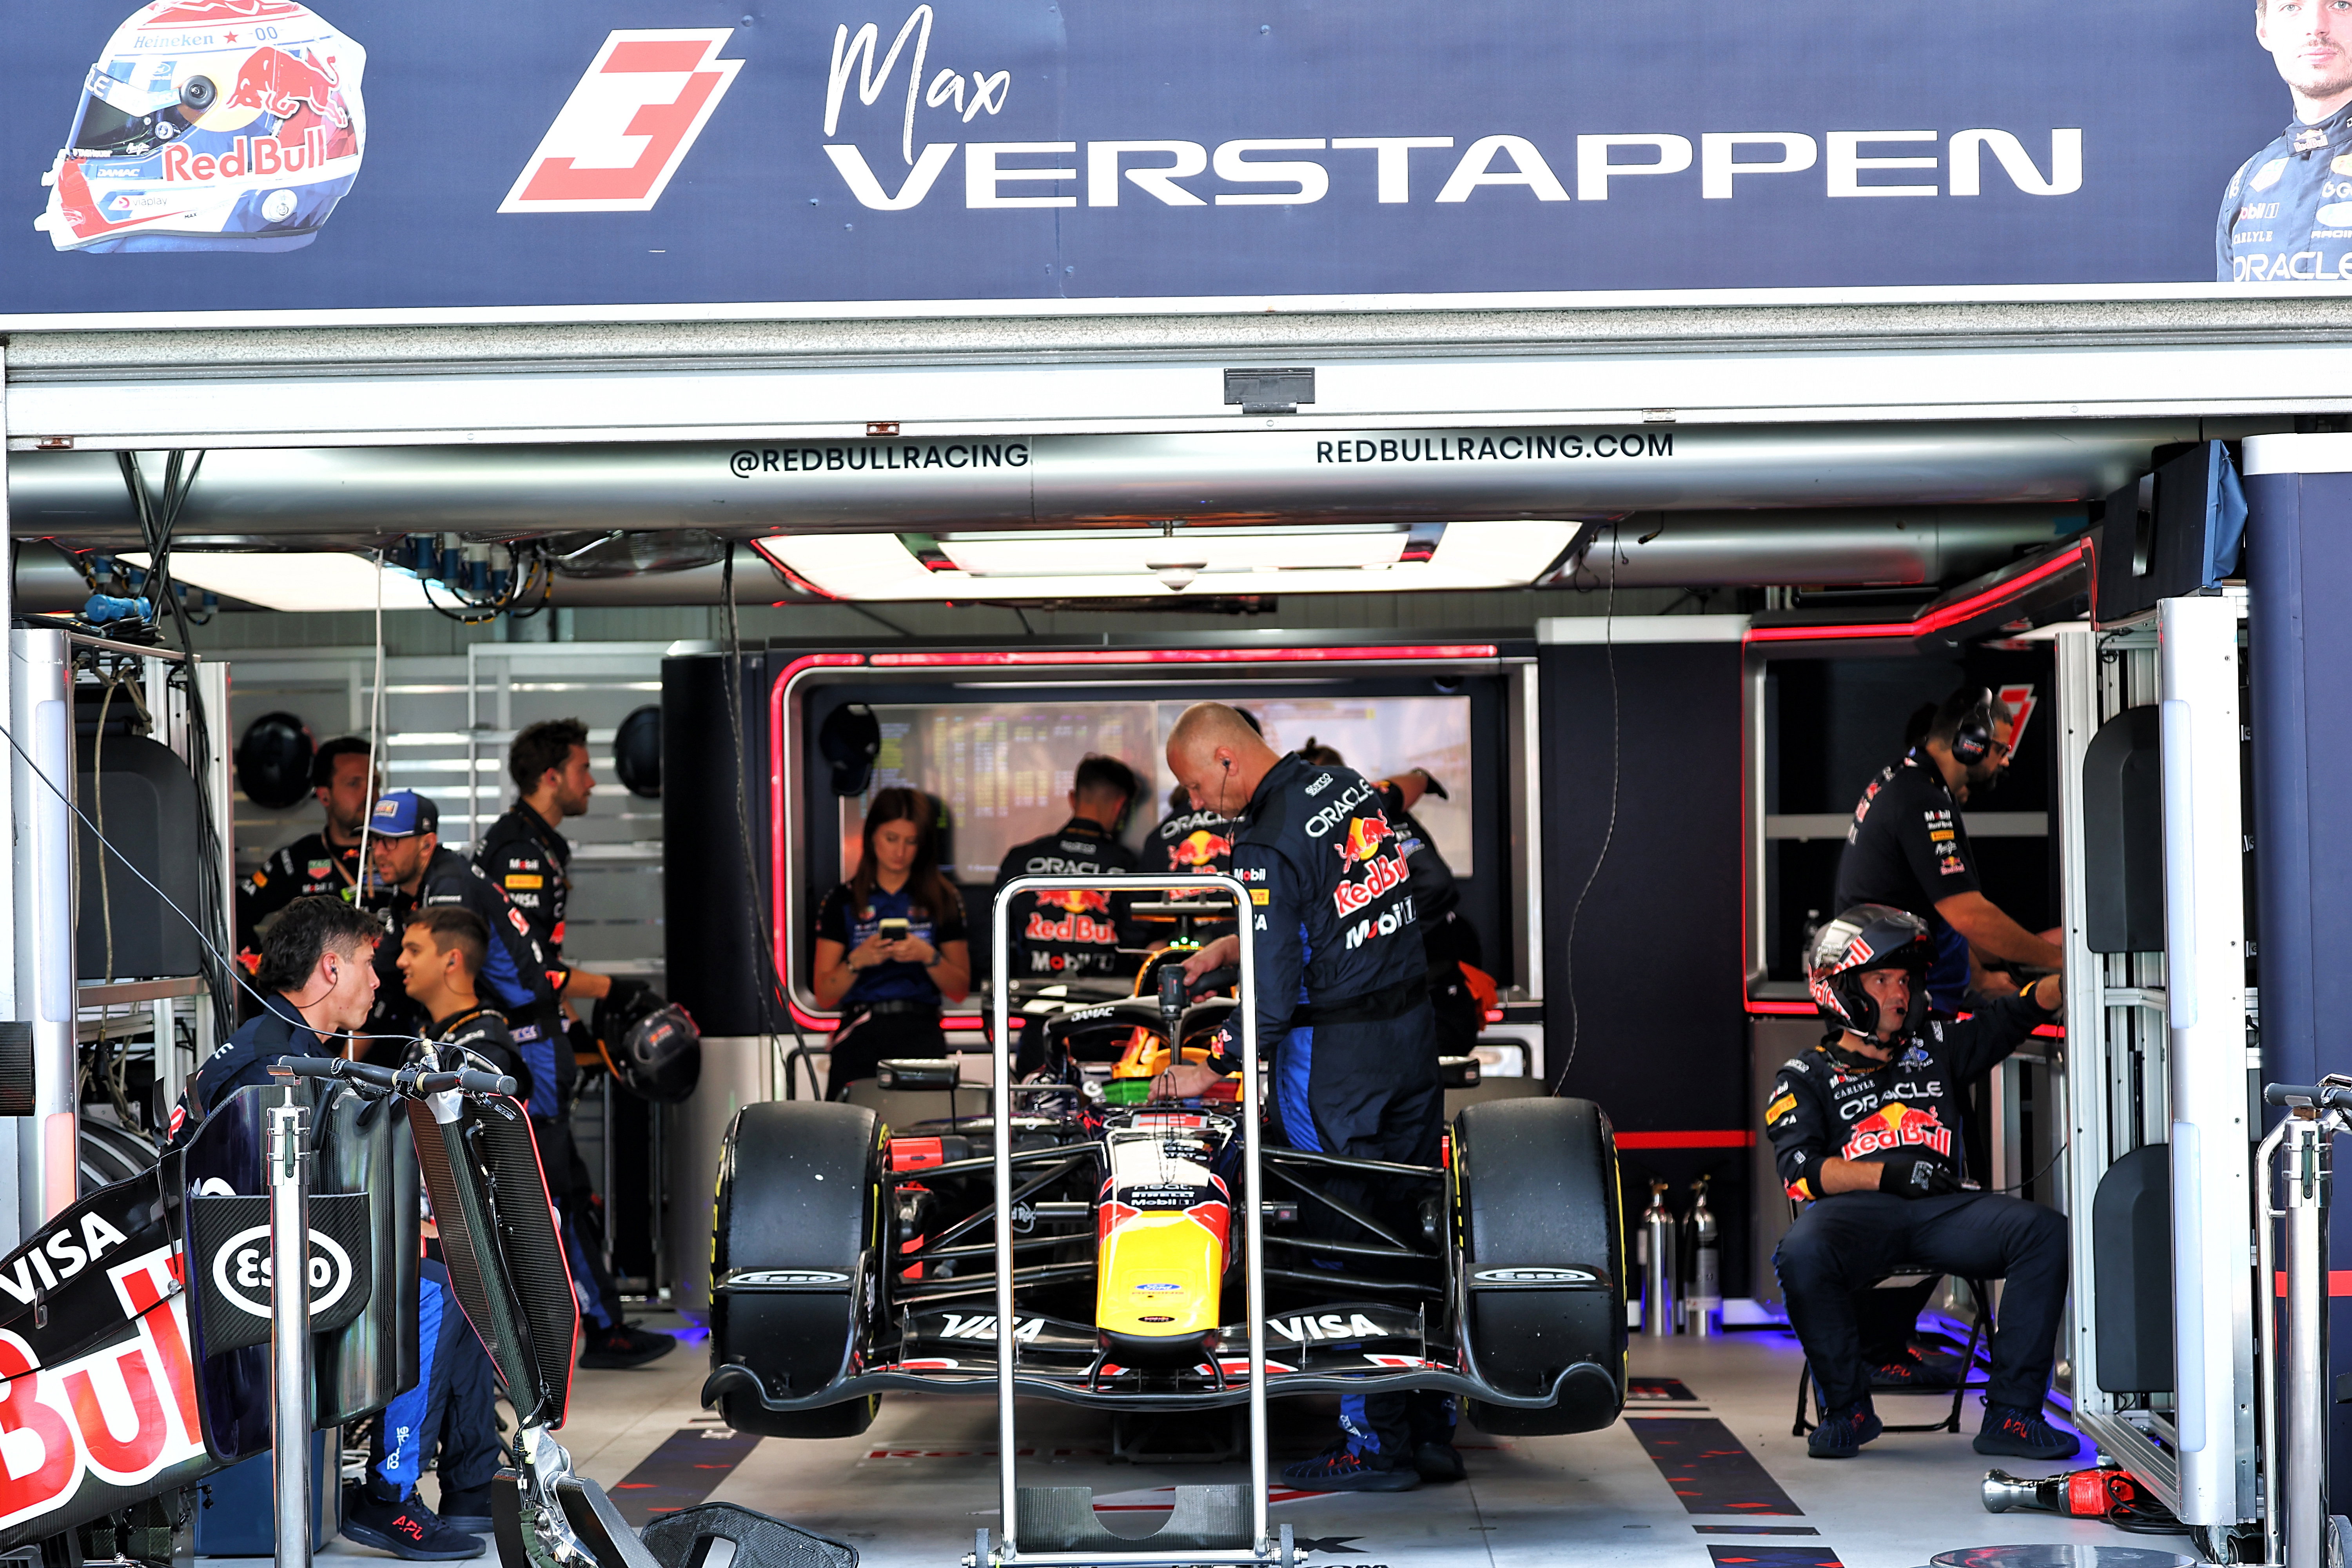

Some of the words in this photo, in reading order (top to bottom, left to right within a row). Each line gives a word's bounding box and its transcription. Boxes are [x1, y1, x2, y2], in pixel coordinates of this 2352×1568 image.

[134, 34, 214, 48] Heineken
[823, 4, 1010, 165] Max
[165, 135, 248, 181] Red
[253, 128, 327, 175] Bull
[822, 127, 2083, 211] VERSTAPPEN
[98, 169, 140, 177] DAMAC
[132, 198, 167, 207] viaplay
[2240, 203, 2266, 220] obil
[2234, 230, 2273, 245] CARLYLE
[2234, 251, 2352, 282] ORACLE
[730, 443, 1029, 478] @REDBULLRACING
[1317, 433, 1673, 463] REDBULLRACING.COM
[1305, 779, 1374, 838] ORACLE
[1161, 810, 1246, 840] ORACL
[1234, 868, 1266, 882] Mobil
[1333, 859, 1385, 919] Red
[1071, 1006, 1115, 1022] DAMAC
[1833, 1079, 1875, 1100] CARLYLE
[1839, 1081, 1944, 1120] ORACLE
[1842, 1129, 1900, 1161] Red
[1900, 1126, 1952, 1158] Bull
[0, 1211, 128, 1305] VISA
[940, 1314, 1045, 1343] VISA
[1266, 1314, 1389, 1342] VISA
[0, 1252, 203, 1523] Bul
